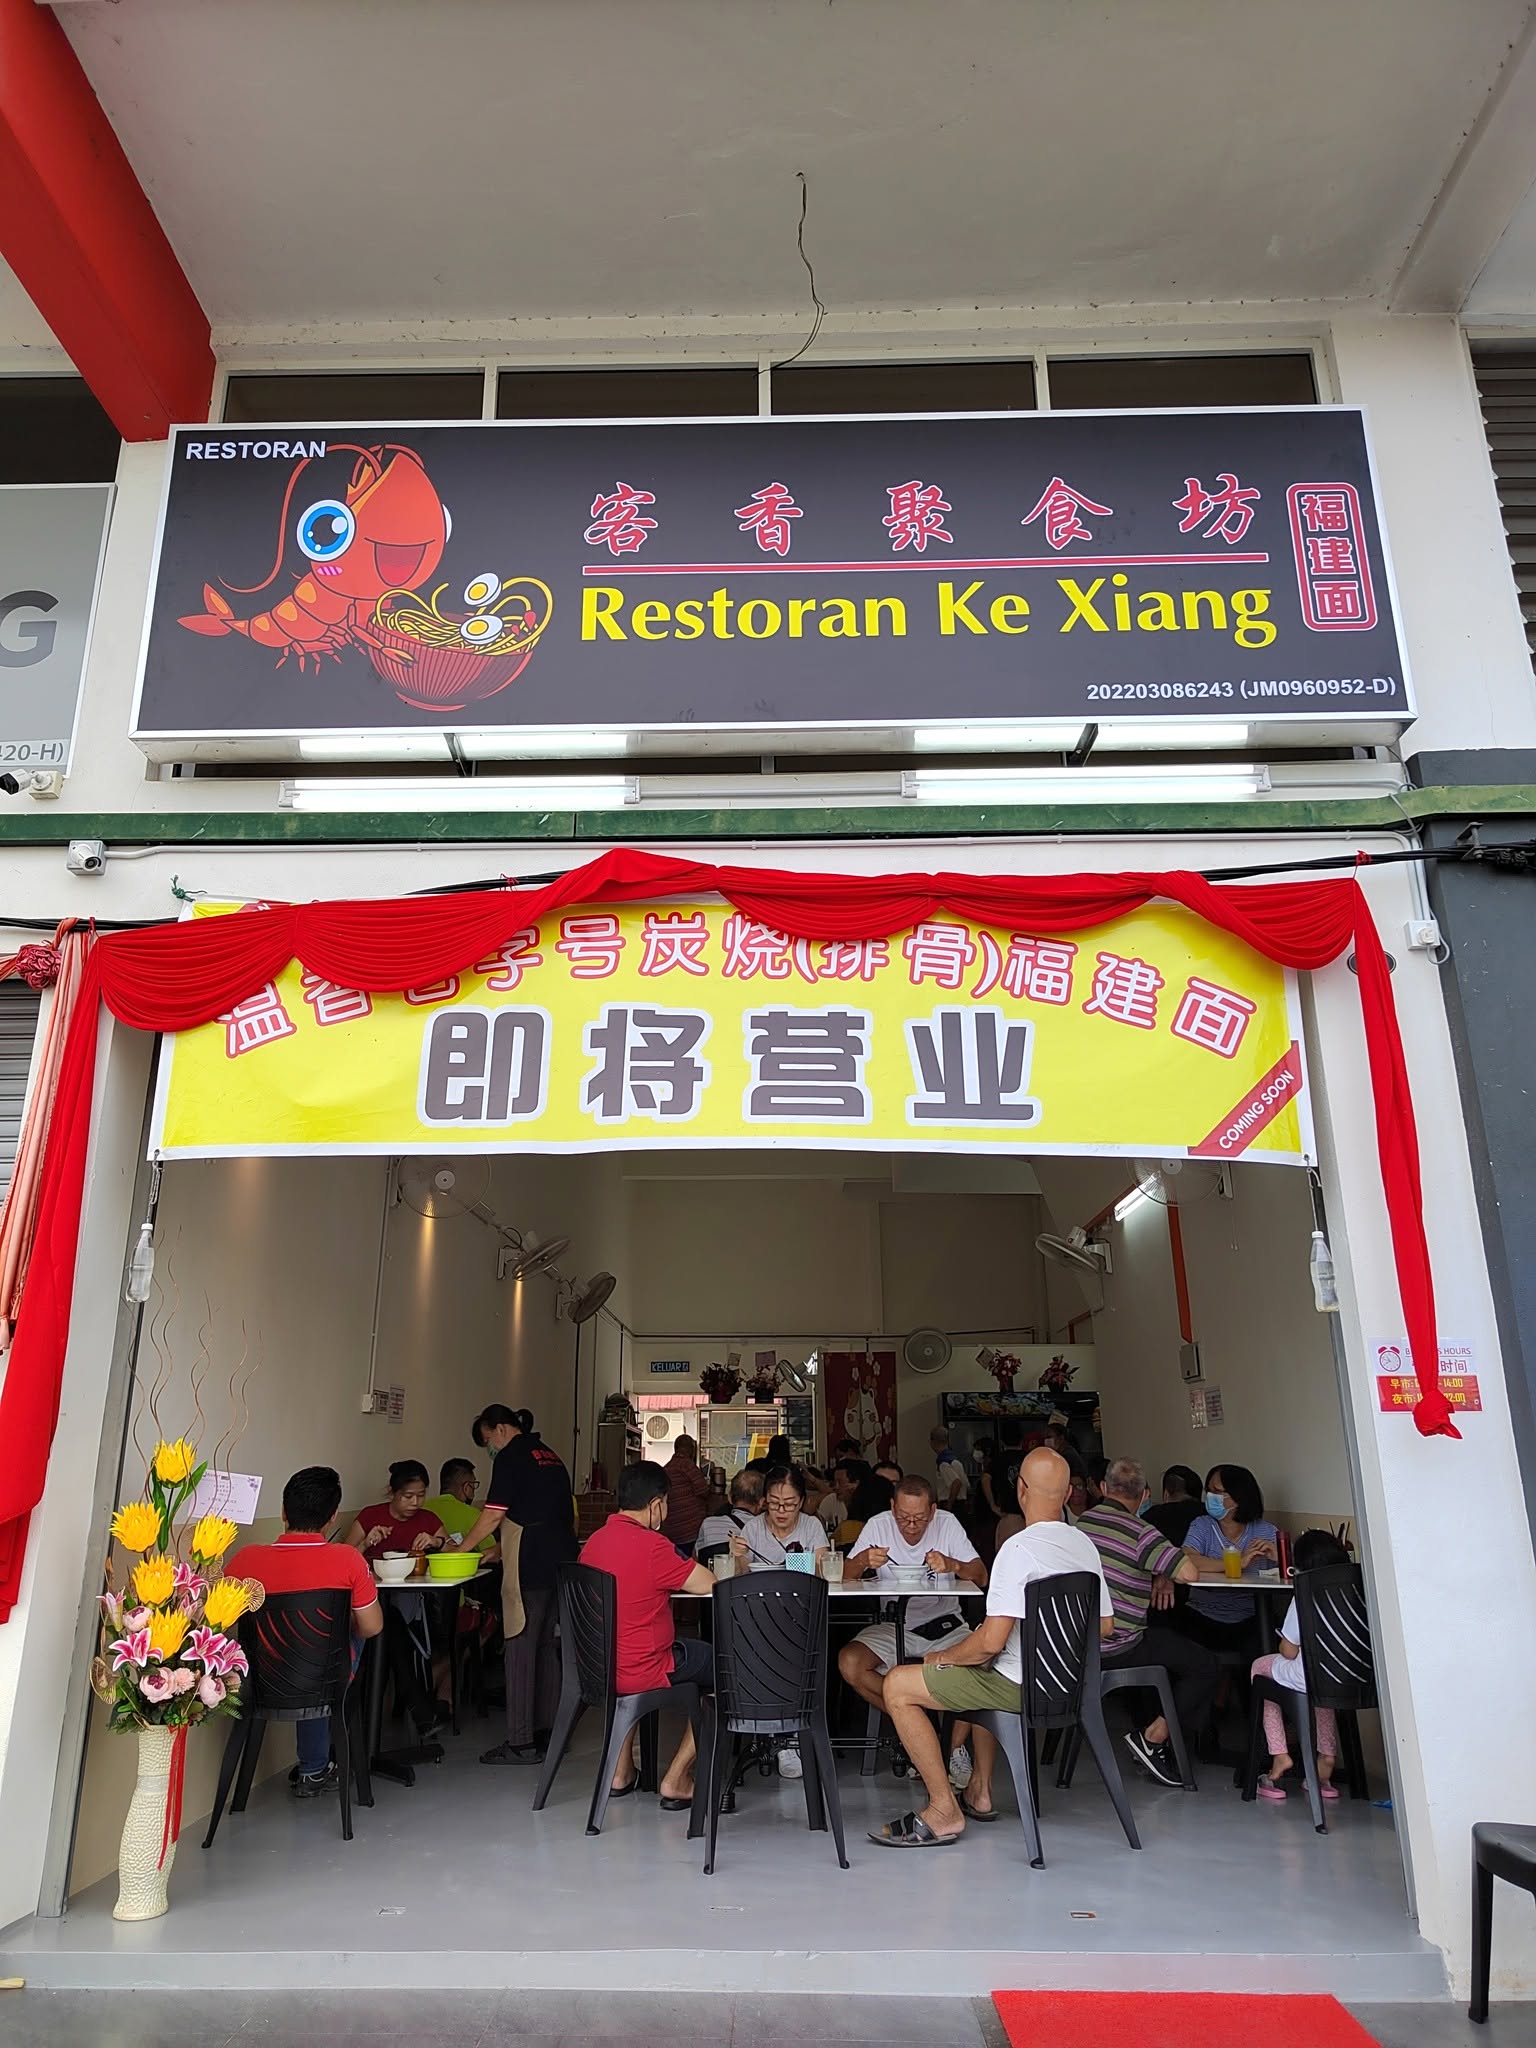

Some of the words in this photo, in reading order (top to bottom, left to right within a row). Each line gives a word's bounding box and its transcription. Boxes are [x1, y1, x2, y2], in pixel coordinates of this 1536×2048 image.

[185, 440, 327, 460] RESTORAN
[583, 474, 1262, 556] 客香聚食坊
[1302, 494, 1361, 620] 福建面
[581, 587, 908, 641] Restoran
[938, 581, 1030, 635] Ke
[1058, 573, 1277, 649] Xiang
[1087, 682, 1234, 700] 202203086243
[1240, 676, 1396, 700] (JM0960952-D)
[0, 742, 64, 763] 20-H)
[427, 1009, 1036, 1122] 即将营业
[1219, 1101, 1265, 1149] COMING
[1260, 1069, 1295, 1105] SOON
[1444, 1347, 1472, 1355] HOURS
